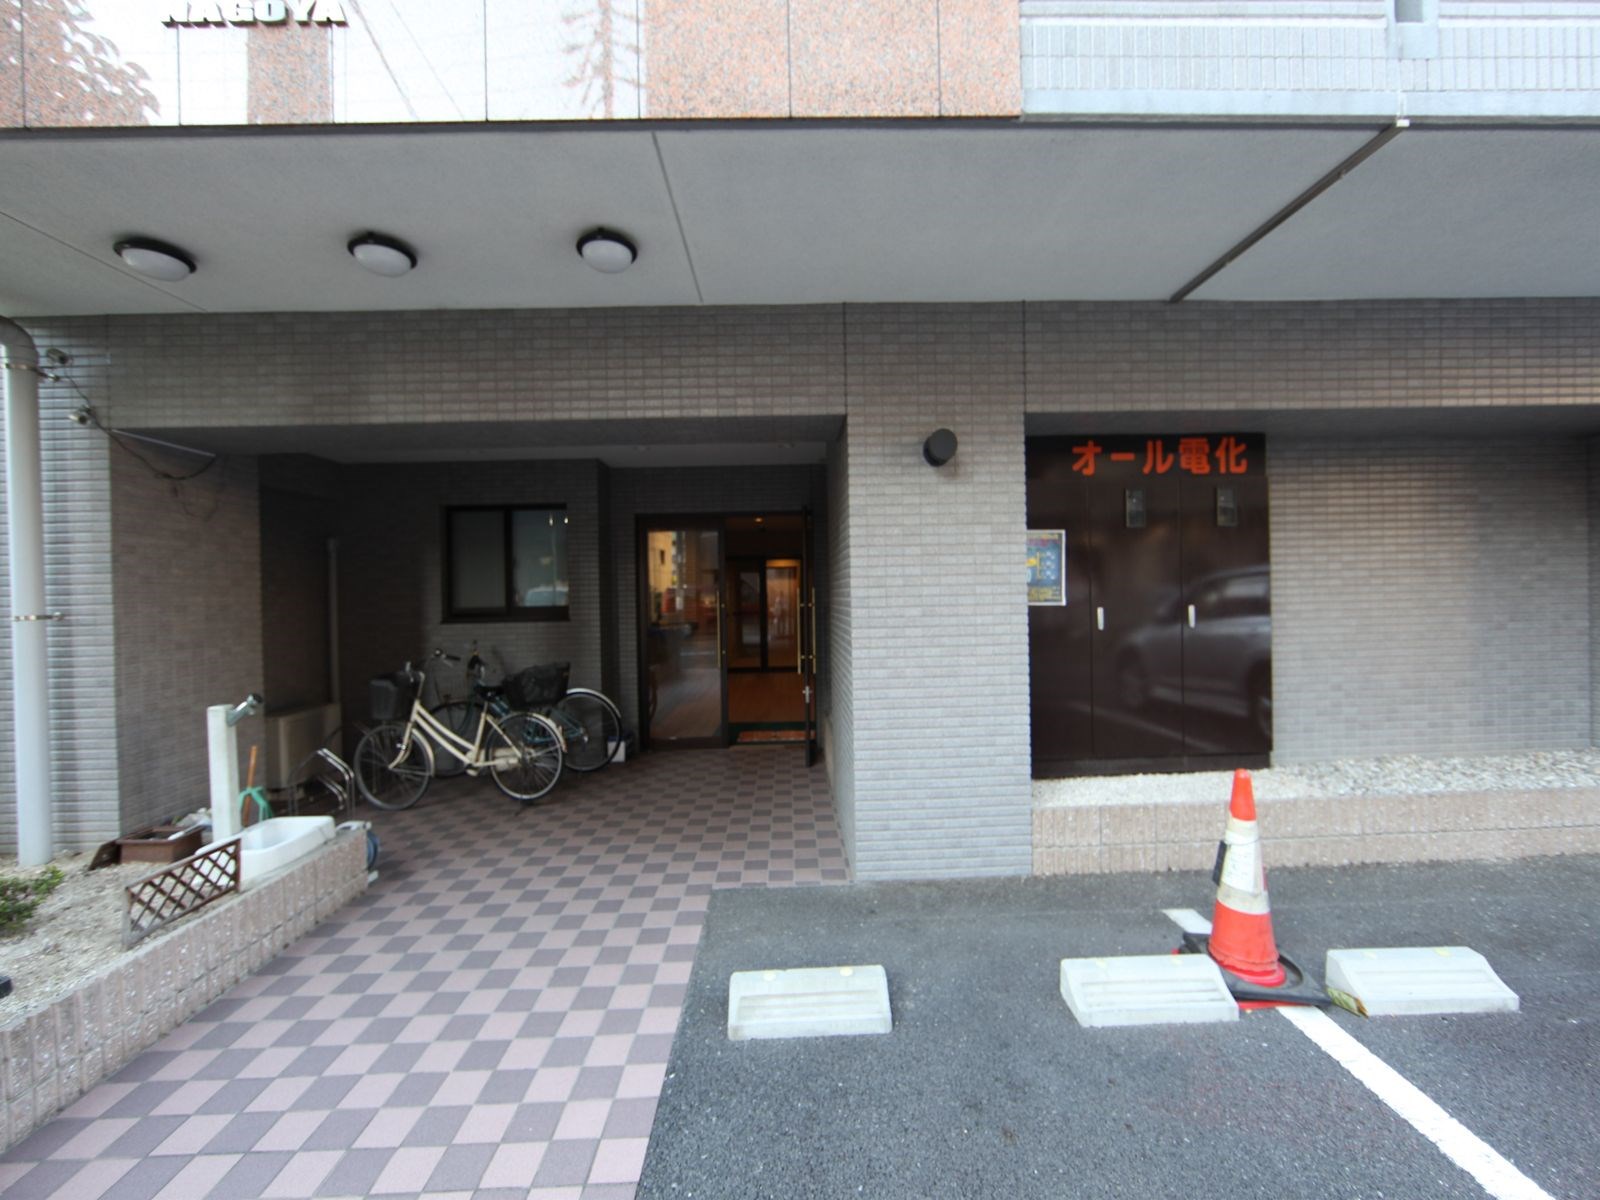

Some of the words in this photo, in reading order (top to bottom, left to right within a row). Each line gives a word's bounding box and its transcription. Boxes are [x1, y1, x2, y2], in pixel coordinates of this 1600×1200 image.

[161, 0, 349, 26] NAGOYA
[1072, 437, 1248, 476] オール電化
